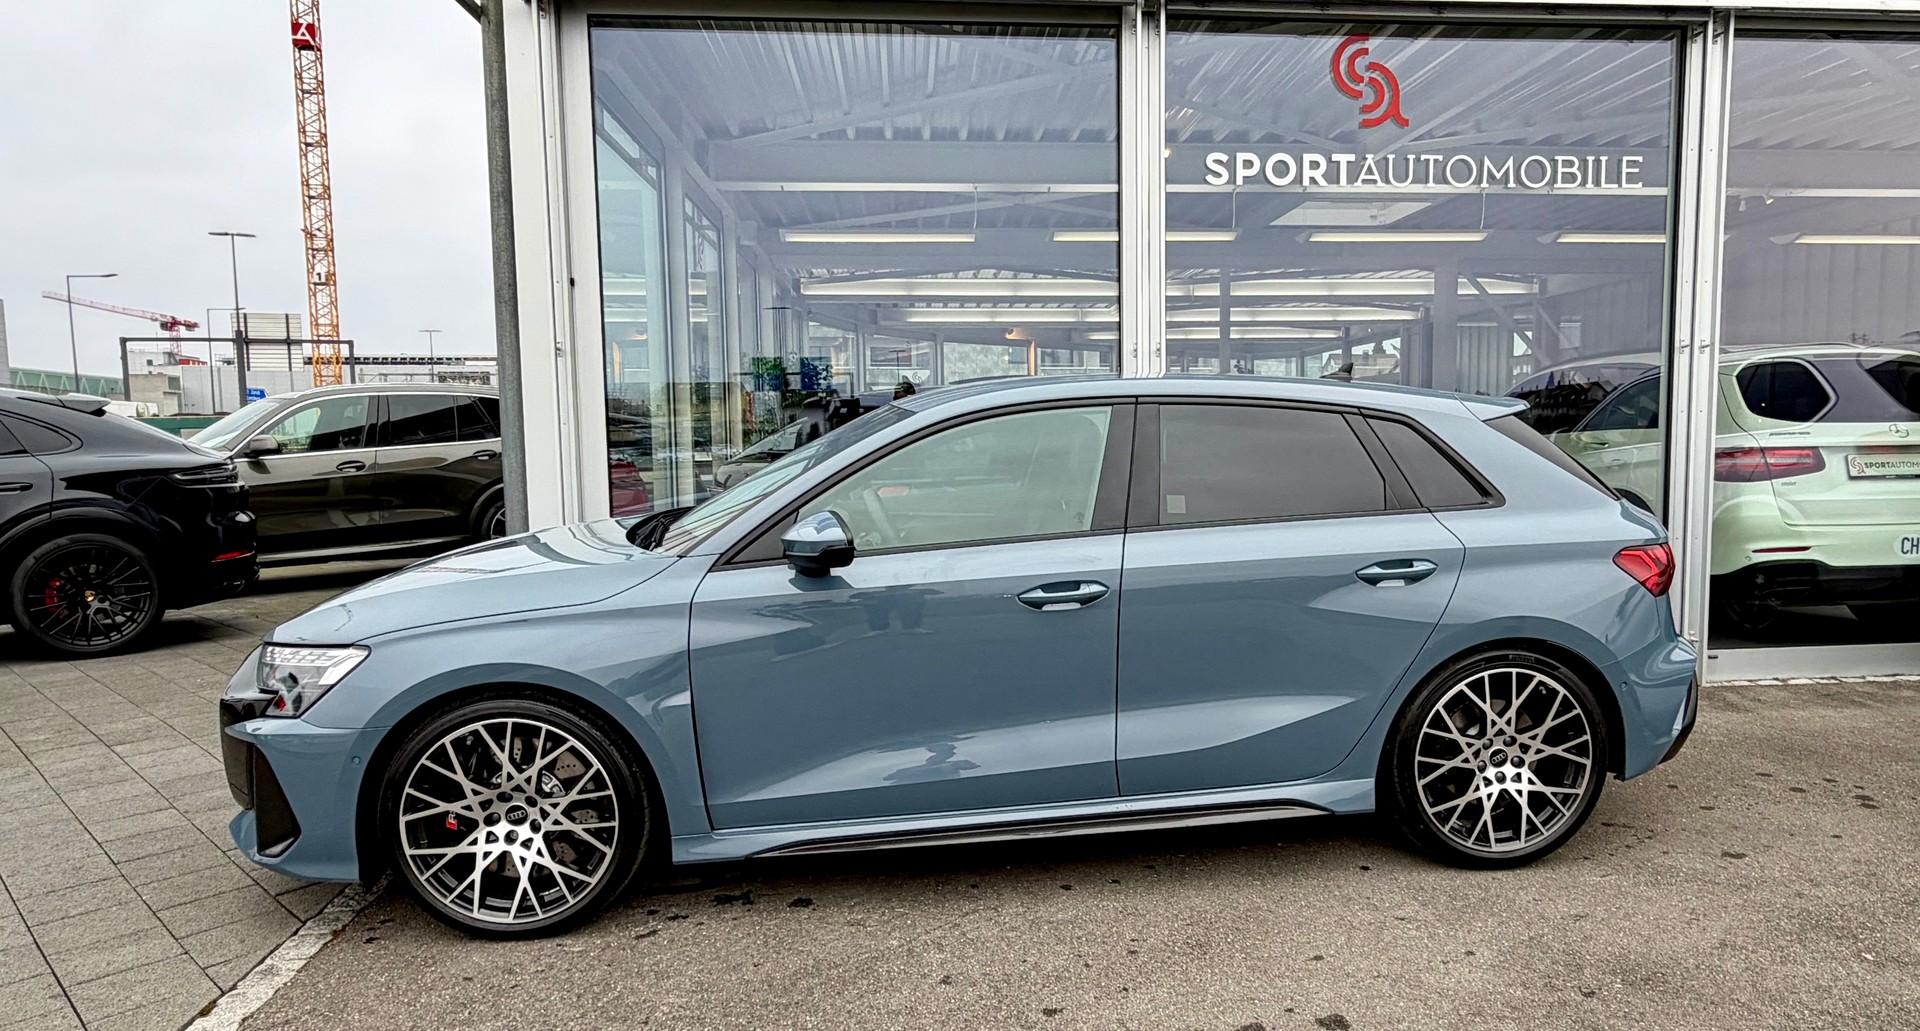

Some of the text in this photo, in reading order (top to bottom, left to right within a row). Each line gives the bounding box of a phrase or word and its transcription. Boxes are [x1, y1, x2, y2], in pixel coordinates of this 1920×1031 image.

[1204, 152, 1644, 189] SPORTAUTOMOBILE
[315, 272, 322, 281] 1
[1864, 461, 1920, 469] SPORTAUTOM
[1900, 536, 1920, 555] CH
